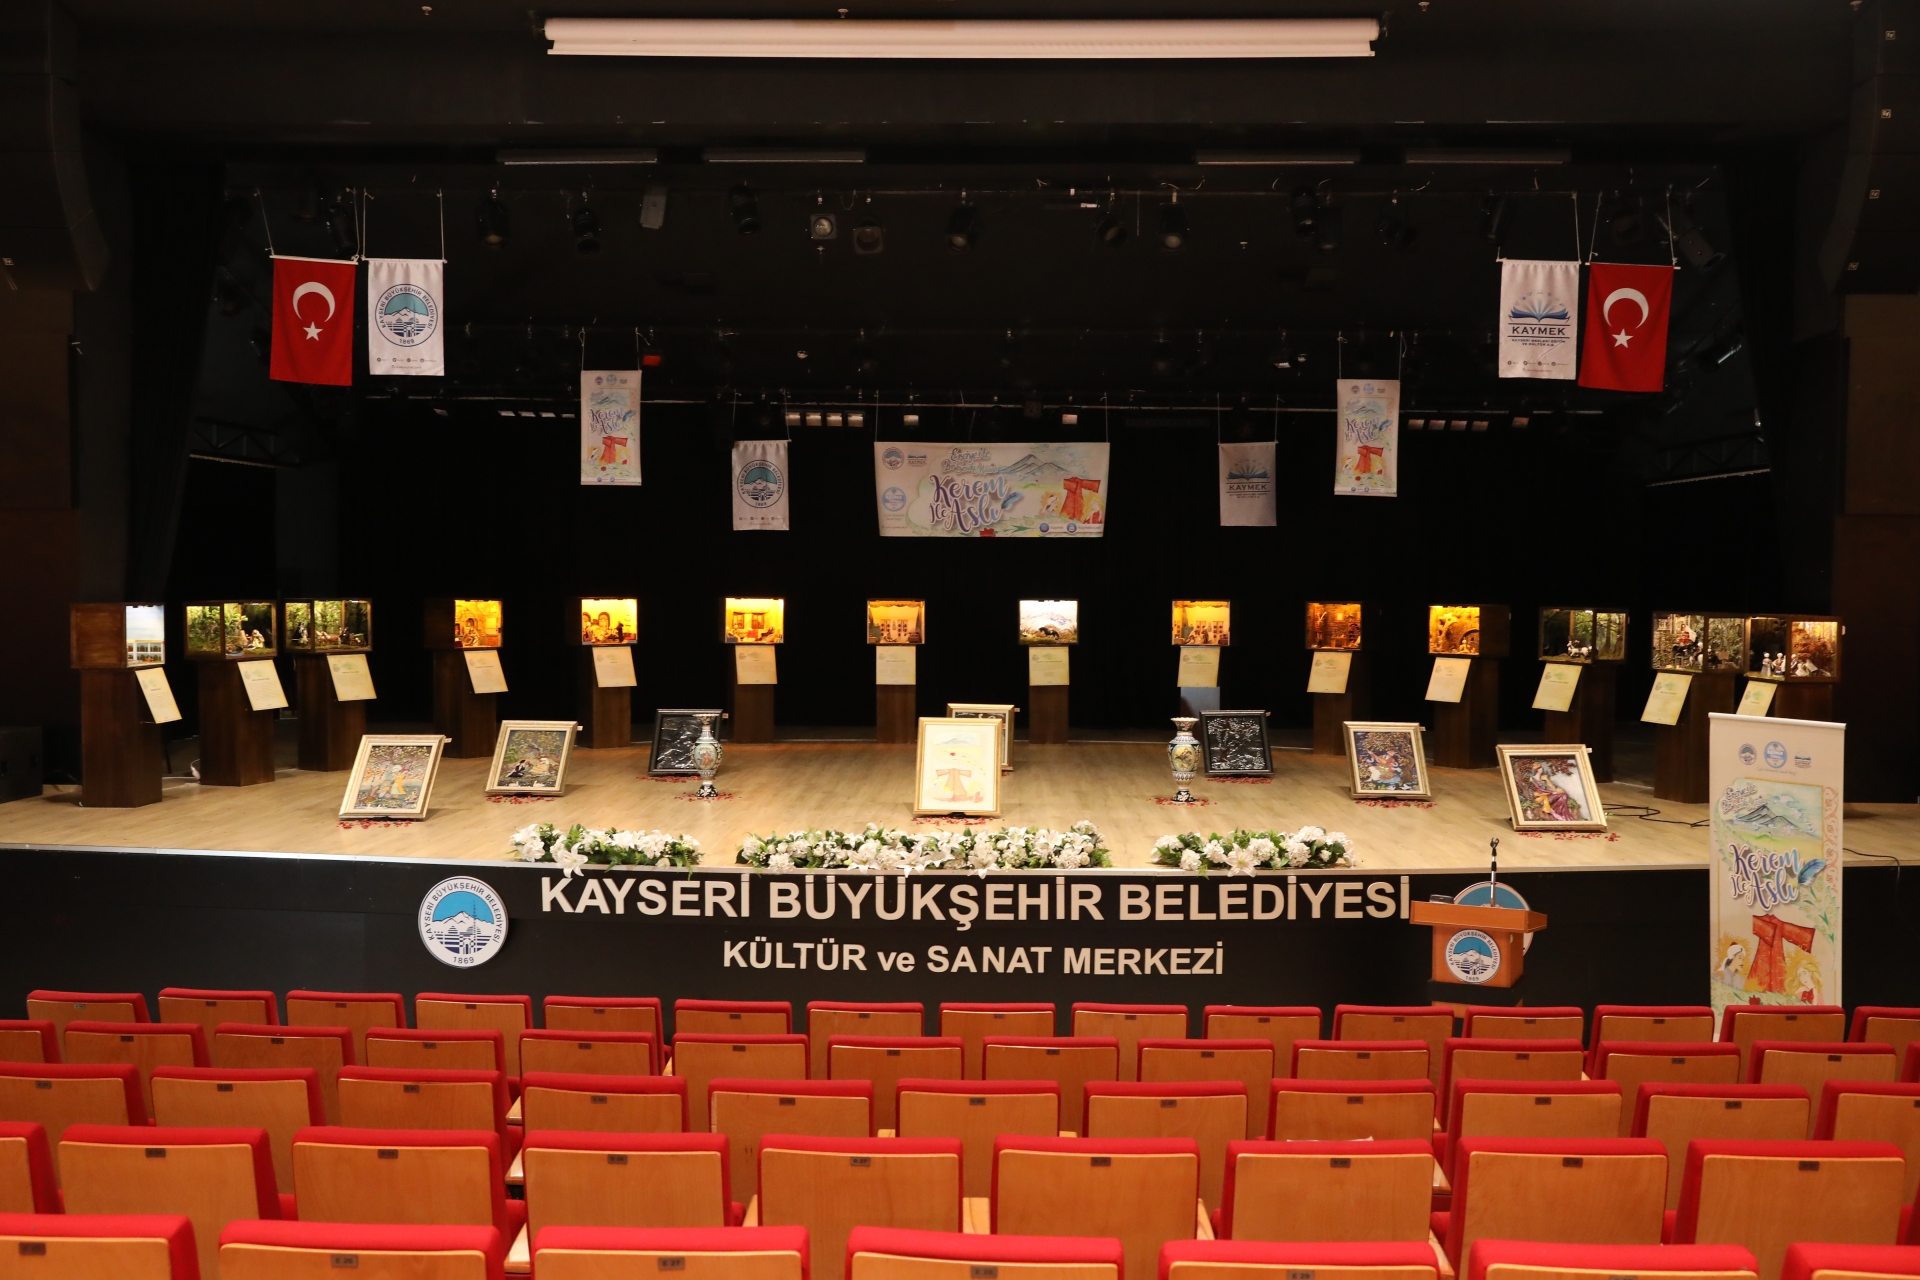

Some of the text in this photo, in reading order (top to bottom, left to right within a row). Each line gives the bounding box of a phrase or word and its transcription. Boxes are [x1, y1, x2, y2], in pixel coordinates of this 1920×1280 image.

[1512, 326, 1566, 336] KAYMEK
[930, 474, 1008, 508] Kerem
[944, 493, 1002, 533] Aslı
[1728, 843, 1803, 881] Kerem
[541, 874, 1410, 931] KAYSERİ BÜYÜKŞEHİR BELEDİYESİ
[1745, 867, 1798, 911] Aslı
[424, 882, 504, 944] KAYSERİ BÜYÜKŞEHİR BELEDİYESİ
[453, 956, 475, 964] 1869
[723, 936, 1224, 975] KÜLTÜR ve SANAT MERKEZİ
